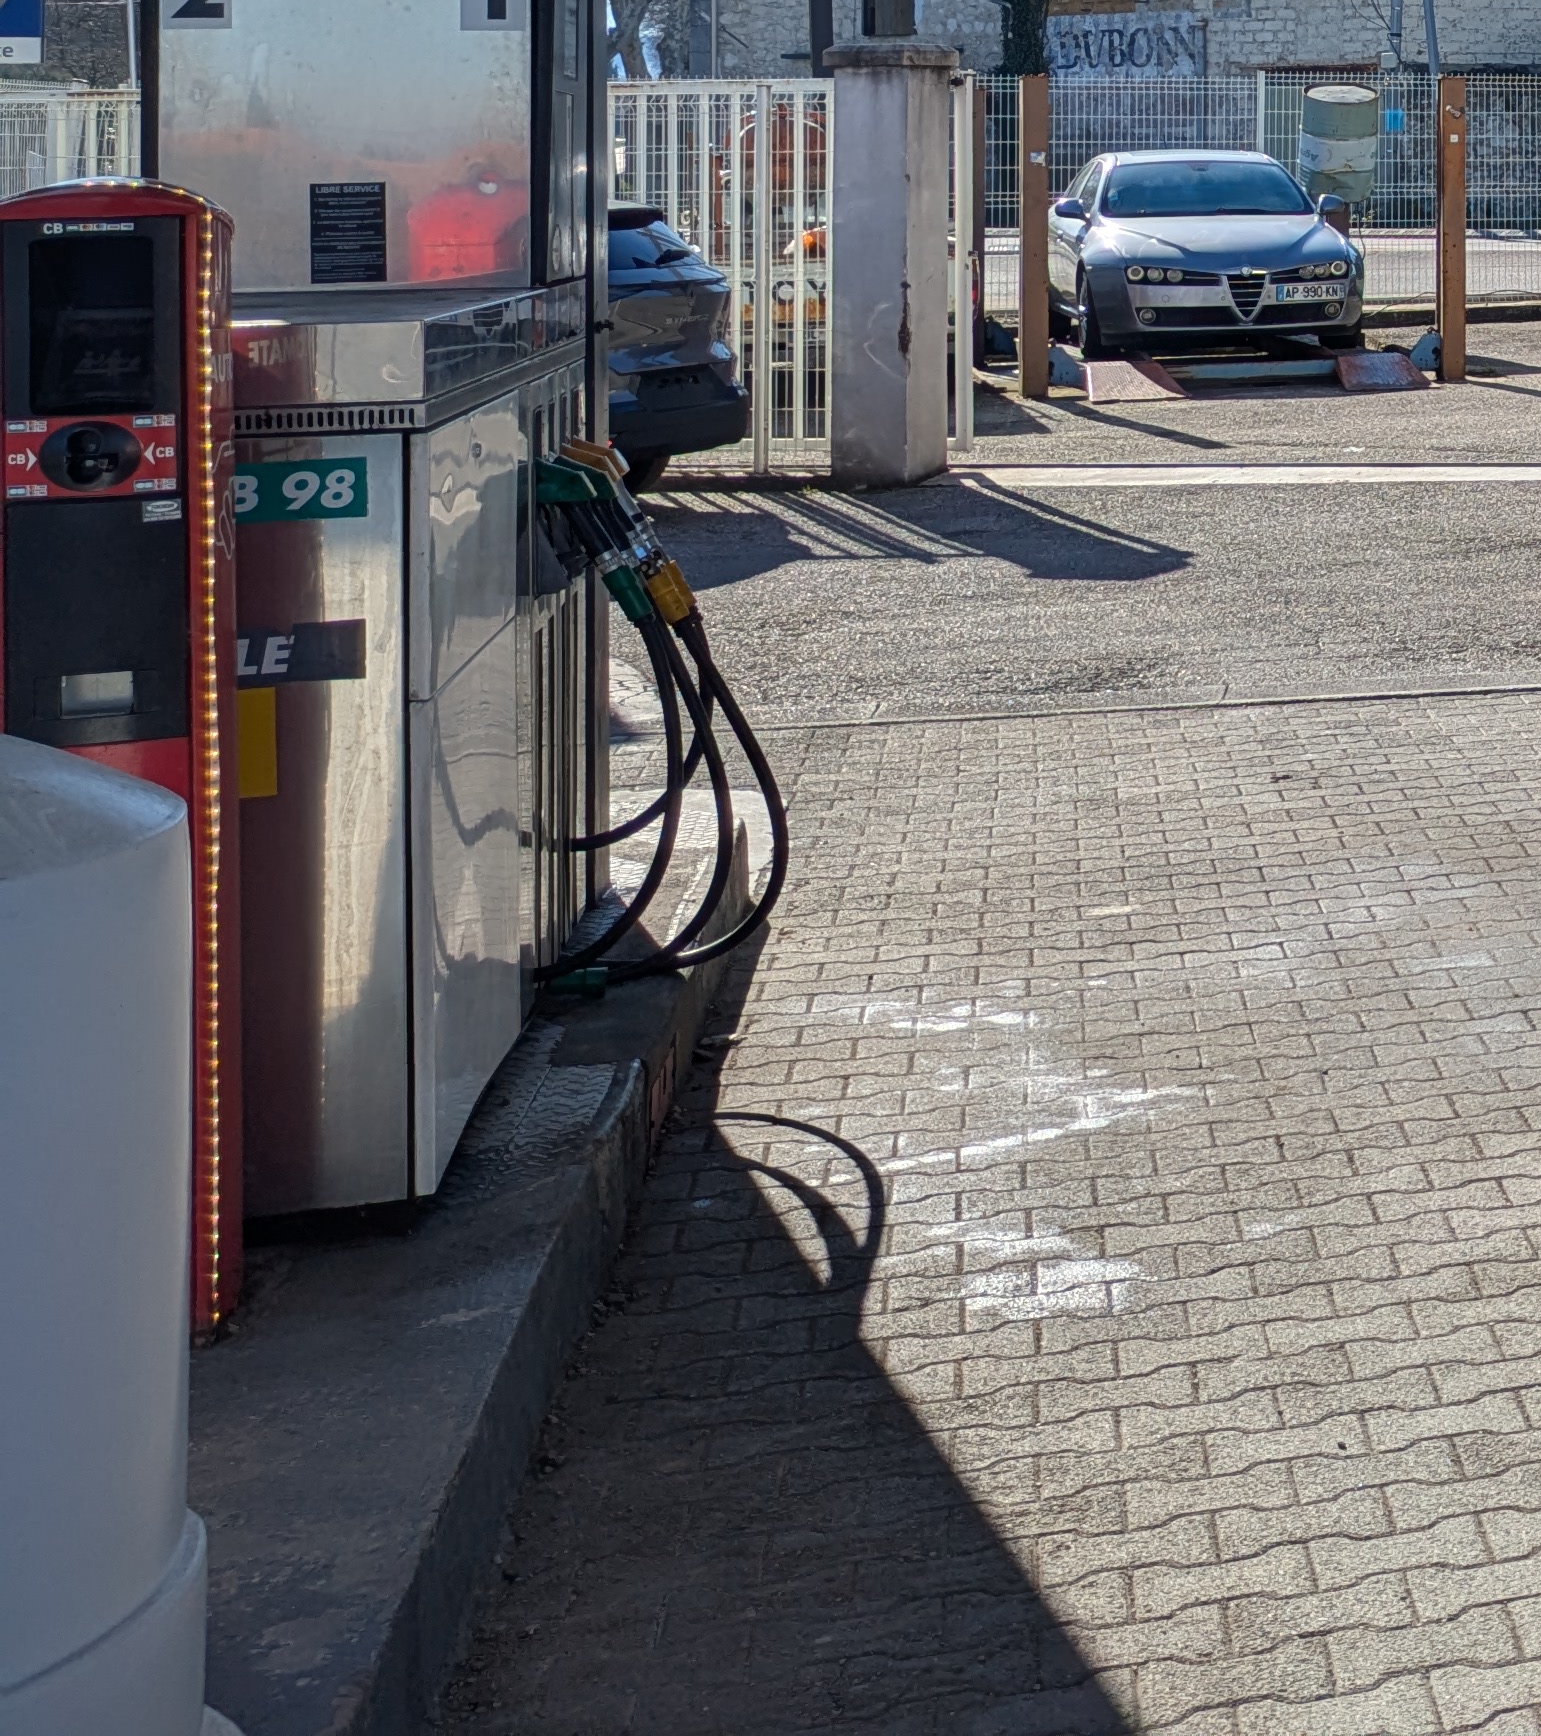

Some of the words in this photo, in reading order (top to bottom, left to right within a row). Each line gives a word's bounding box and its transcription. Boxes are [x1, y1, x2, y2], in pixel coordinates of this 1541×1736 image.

[0, 45, 14, 58] e
[315, 185, 342, 194] LIBRE
[343, 184, 381, 193] SERVICE
[43, 222, 64, 235] CB
[156, 446, 175, 458] CB
[8, 453, 26, 465] CB
[232, 475, 259, 513] B
[282, 469, 356, 511] 98
[236, 635, 293, 676] LE
